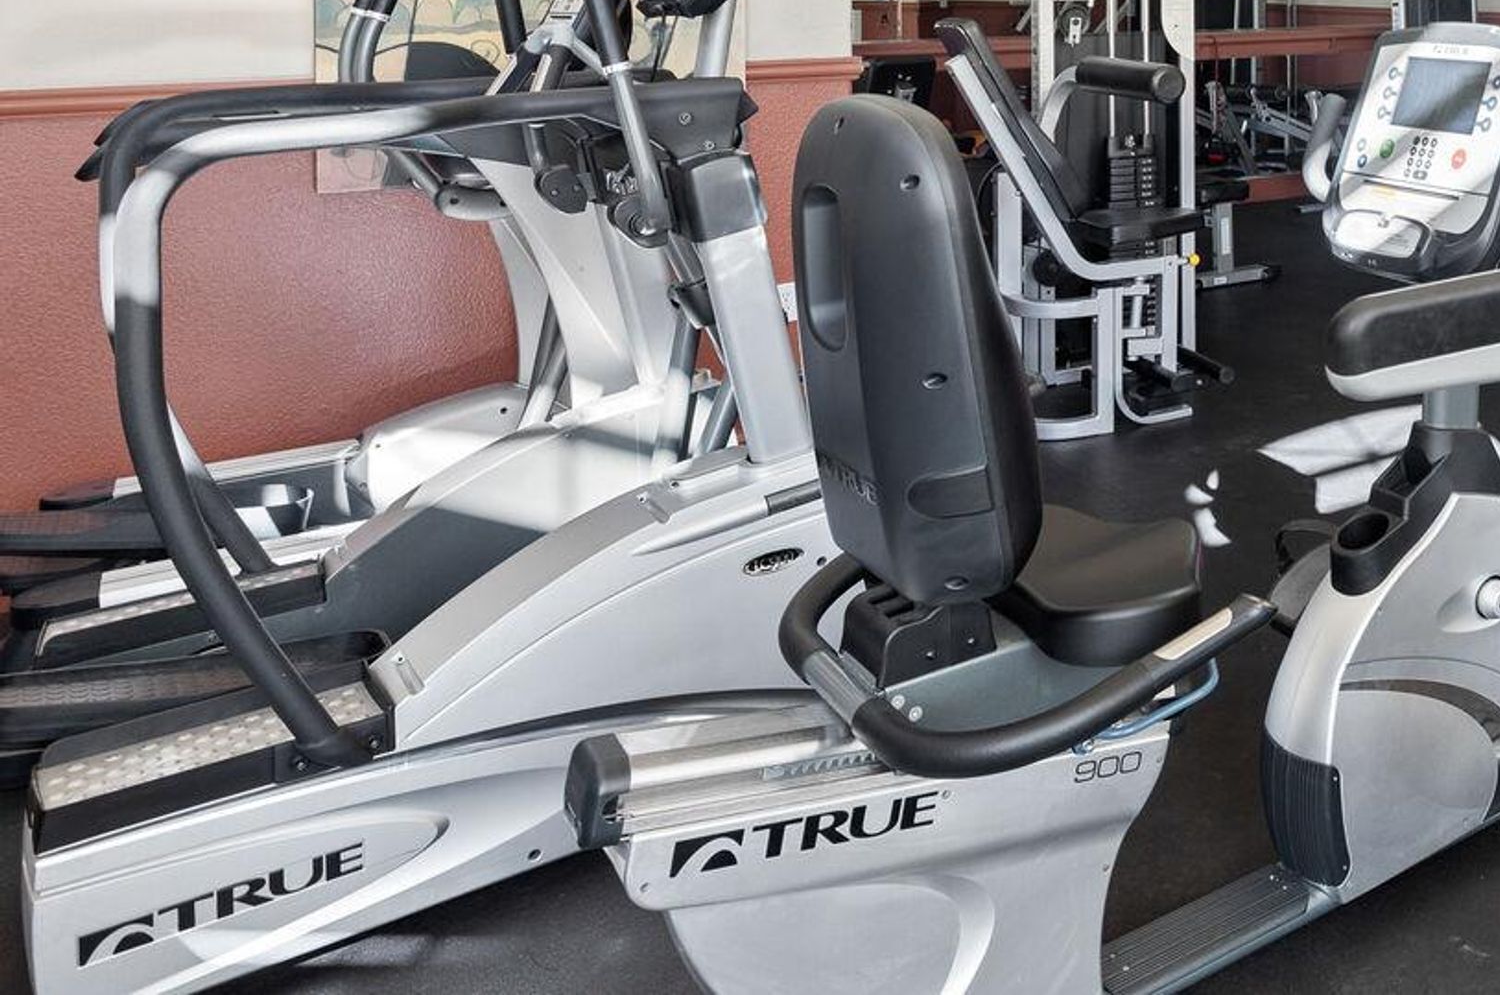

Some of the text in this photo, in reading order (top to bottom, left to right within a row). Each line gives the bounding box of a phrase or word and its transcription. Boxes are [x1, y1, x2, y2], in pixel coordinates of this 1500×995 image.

[1073, 751, 1143, 784] 900
[752, 791, 939, 859] TRUE
[158, 839, 364, 933] TRUE
